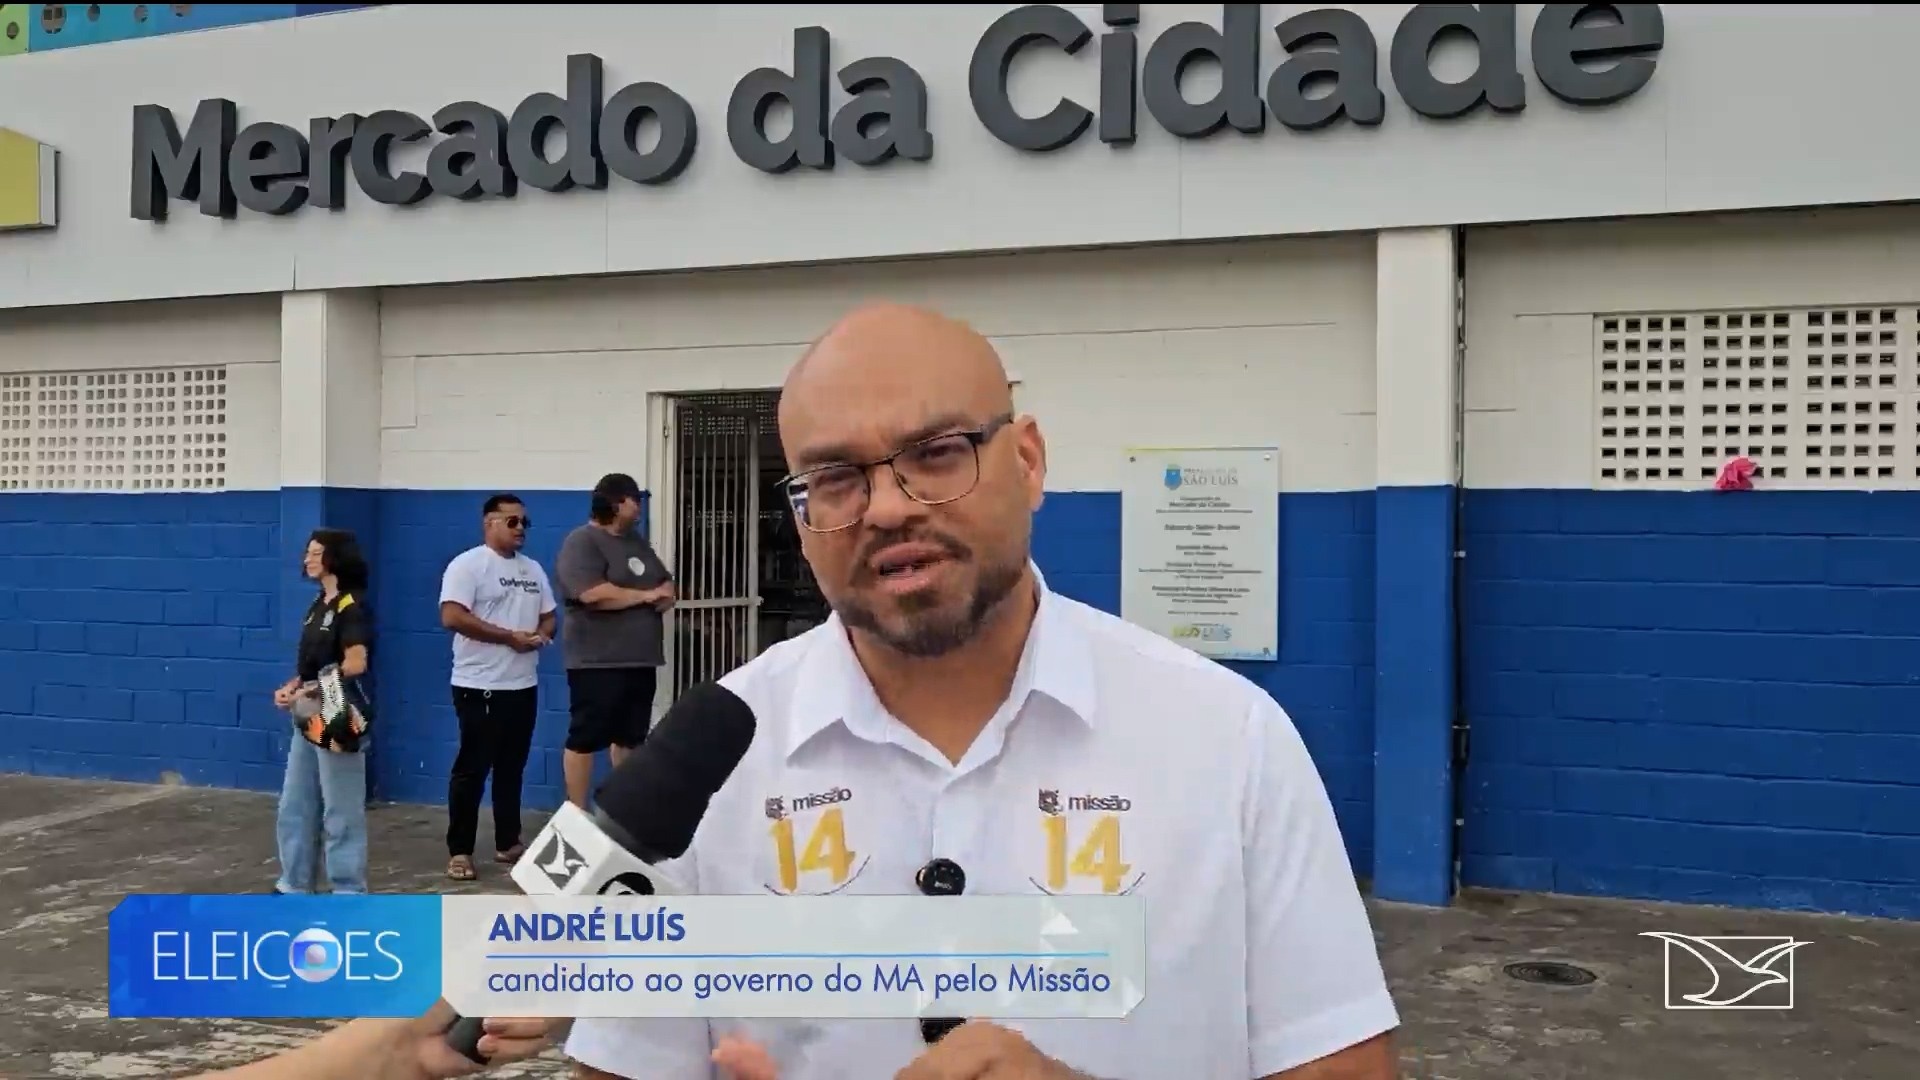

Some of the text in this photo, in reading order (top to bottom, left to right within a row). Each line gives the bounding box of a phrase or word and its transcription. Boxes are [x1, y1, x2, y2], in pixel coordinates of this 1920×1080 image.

[131, 3, 1664, 222] Mercado da Cidade
[793, 787, 852, 812] missão
[1069, 795, 1131, 811] missão
[769, 808, 856, 892] 14
[1044, 815, 1131, 893] 14
